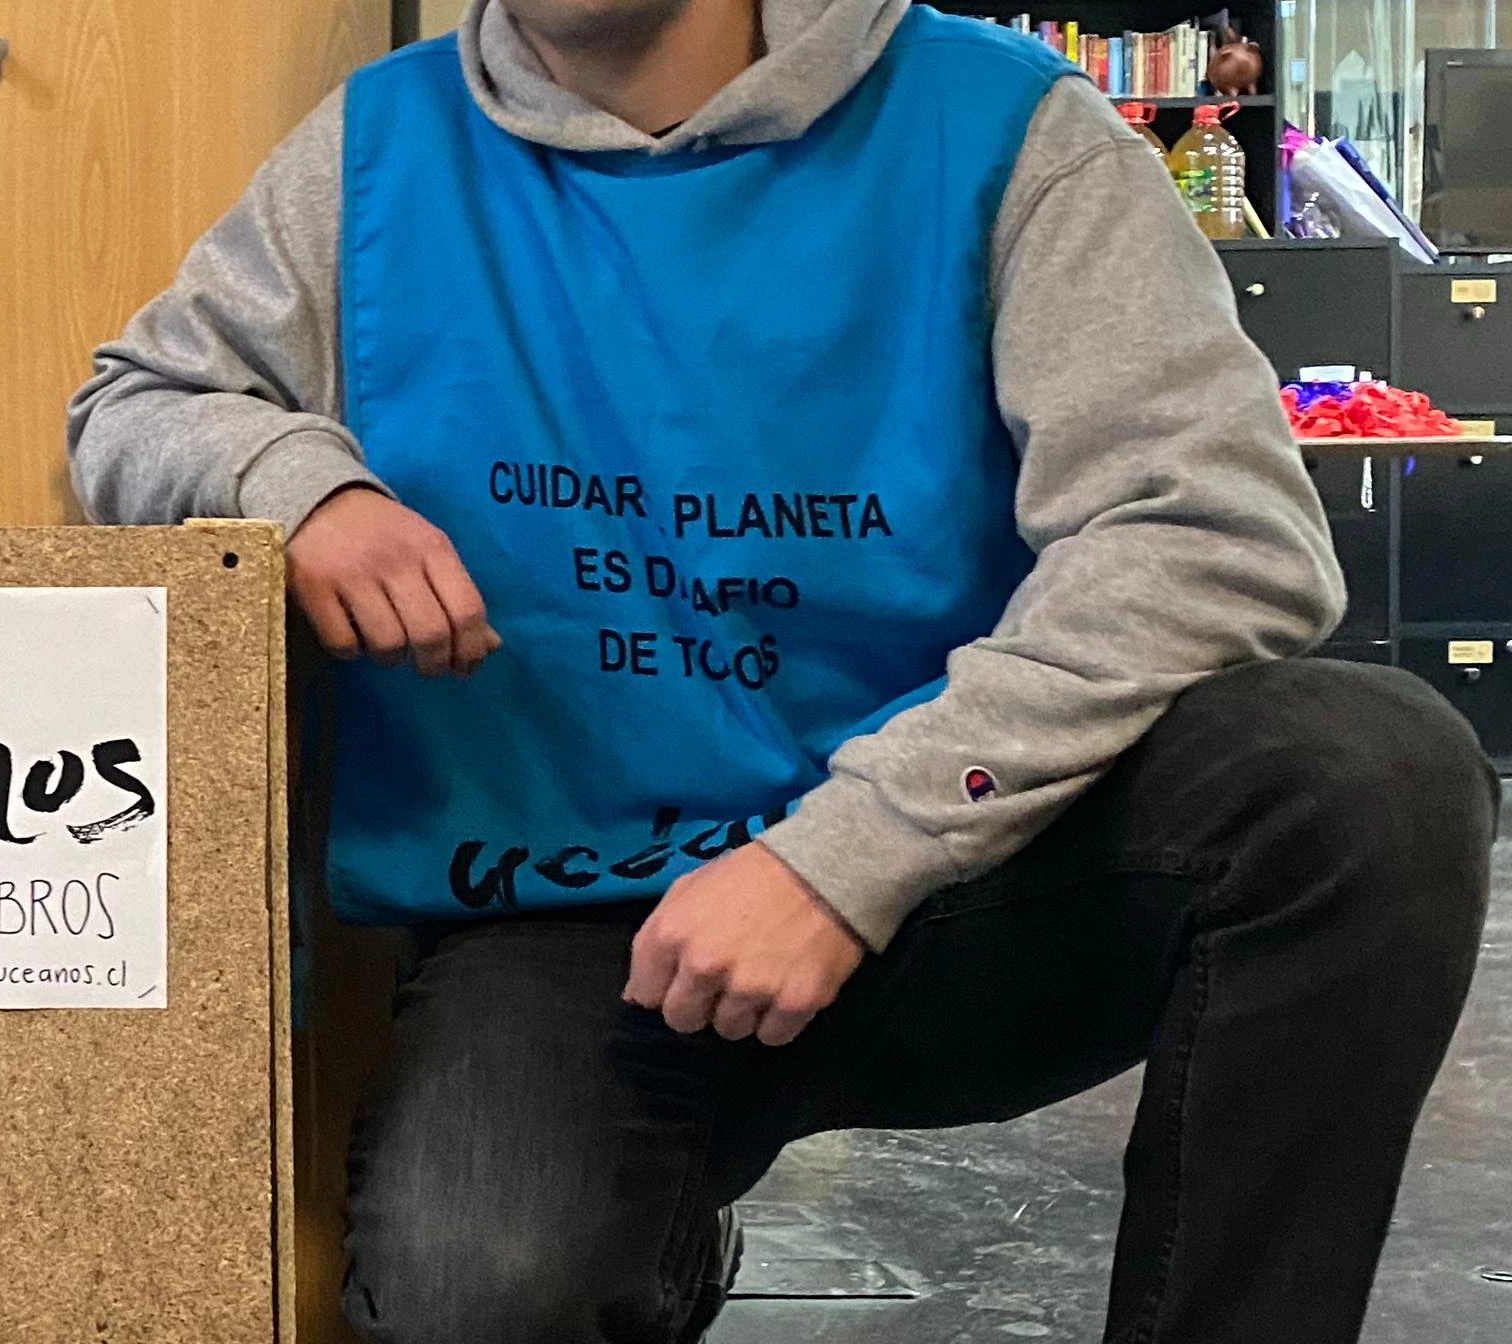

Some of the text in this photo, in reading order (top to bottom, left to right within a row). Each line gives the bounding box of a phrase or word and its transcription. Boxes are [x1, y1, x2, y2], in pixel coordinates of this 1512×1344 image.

[490, 460, 893, 538] CUIDAR PLANETA
[574, 547, 800, 613] ES DAFIO
[599, 628, 658, 676] DE
